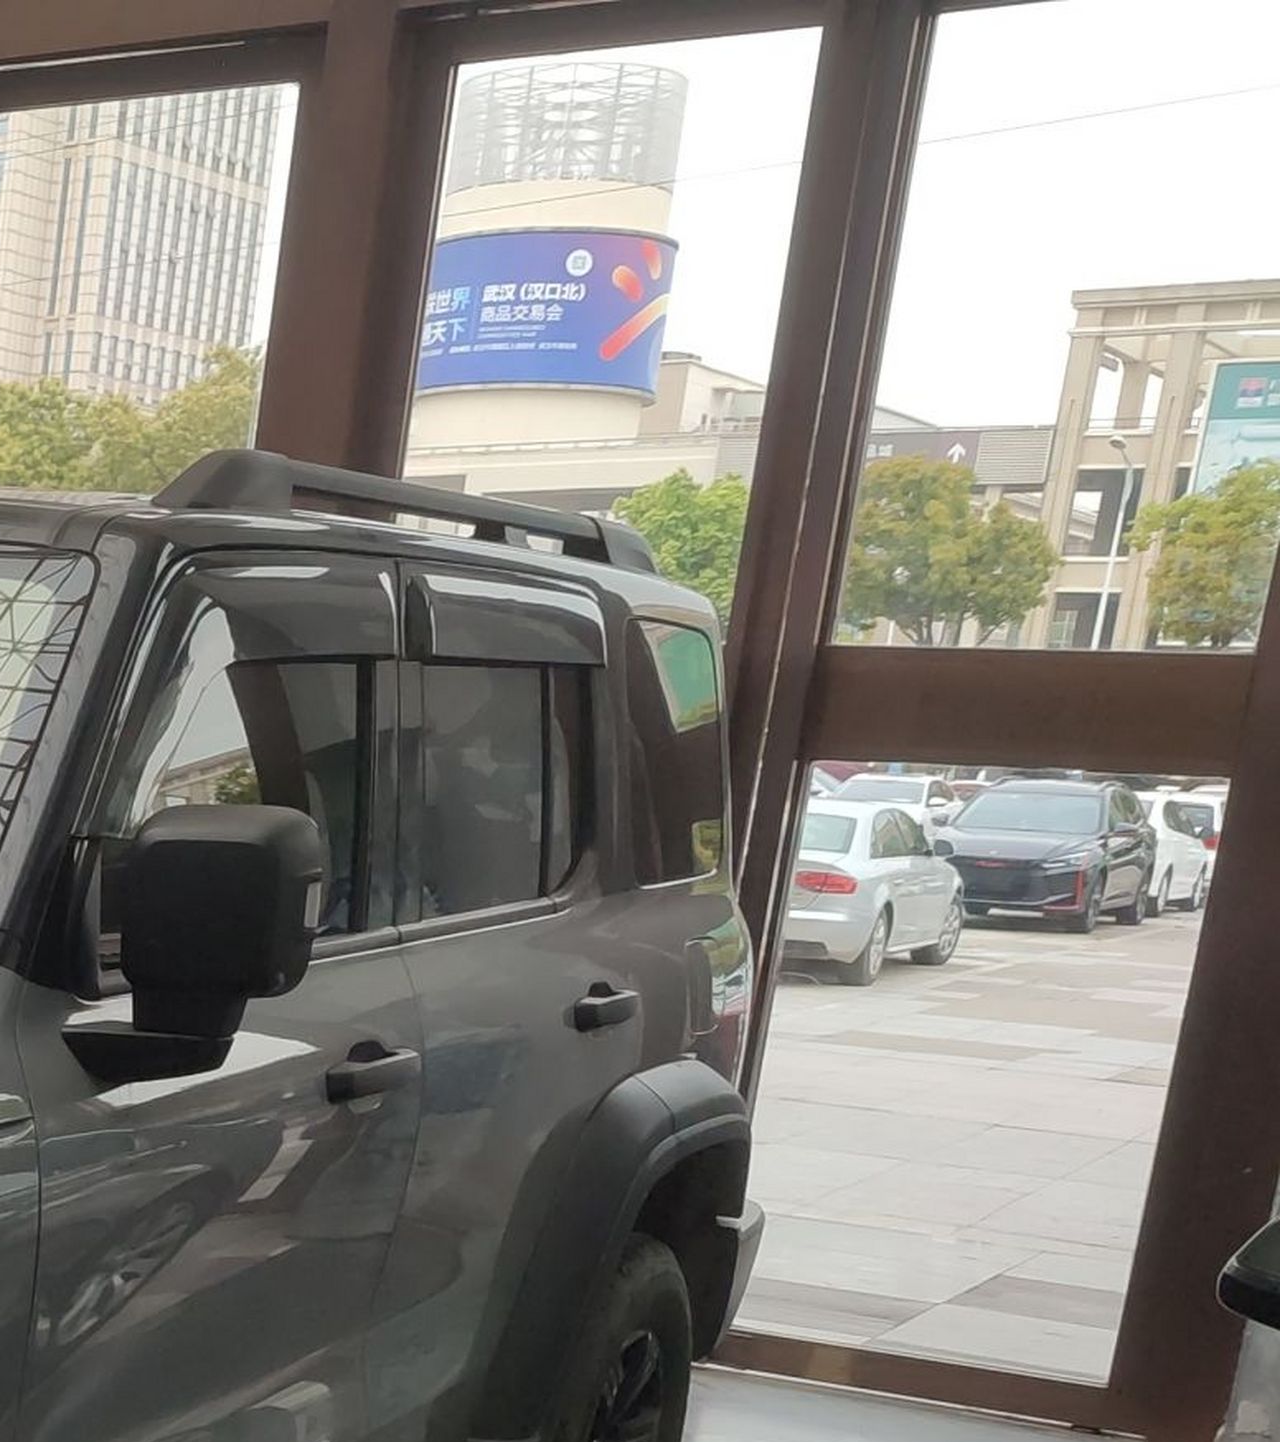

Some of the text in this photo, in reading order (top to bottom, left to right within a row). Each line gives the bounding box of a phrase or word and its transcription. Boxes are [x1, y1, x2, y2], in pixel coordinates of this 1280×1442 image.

[480, 303, 564, 322] 商品交易会
